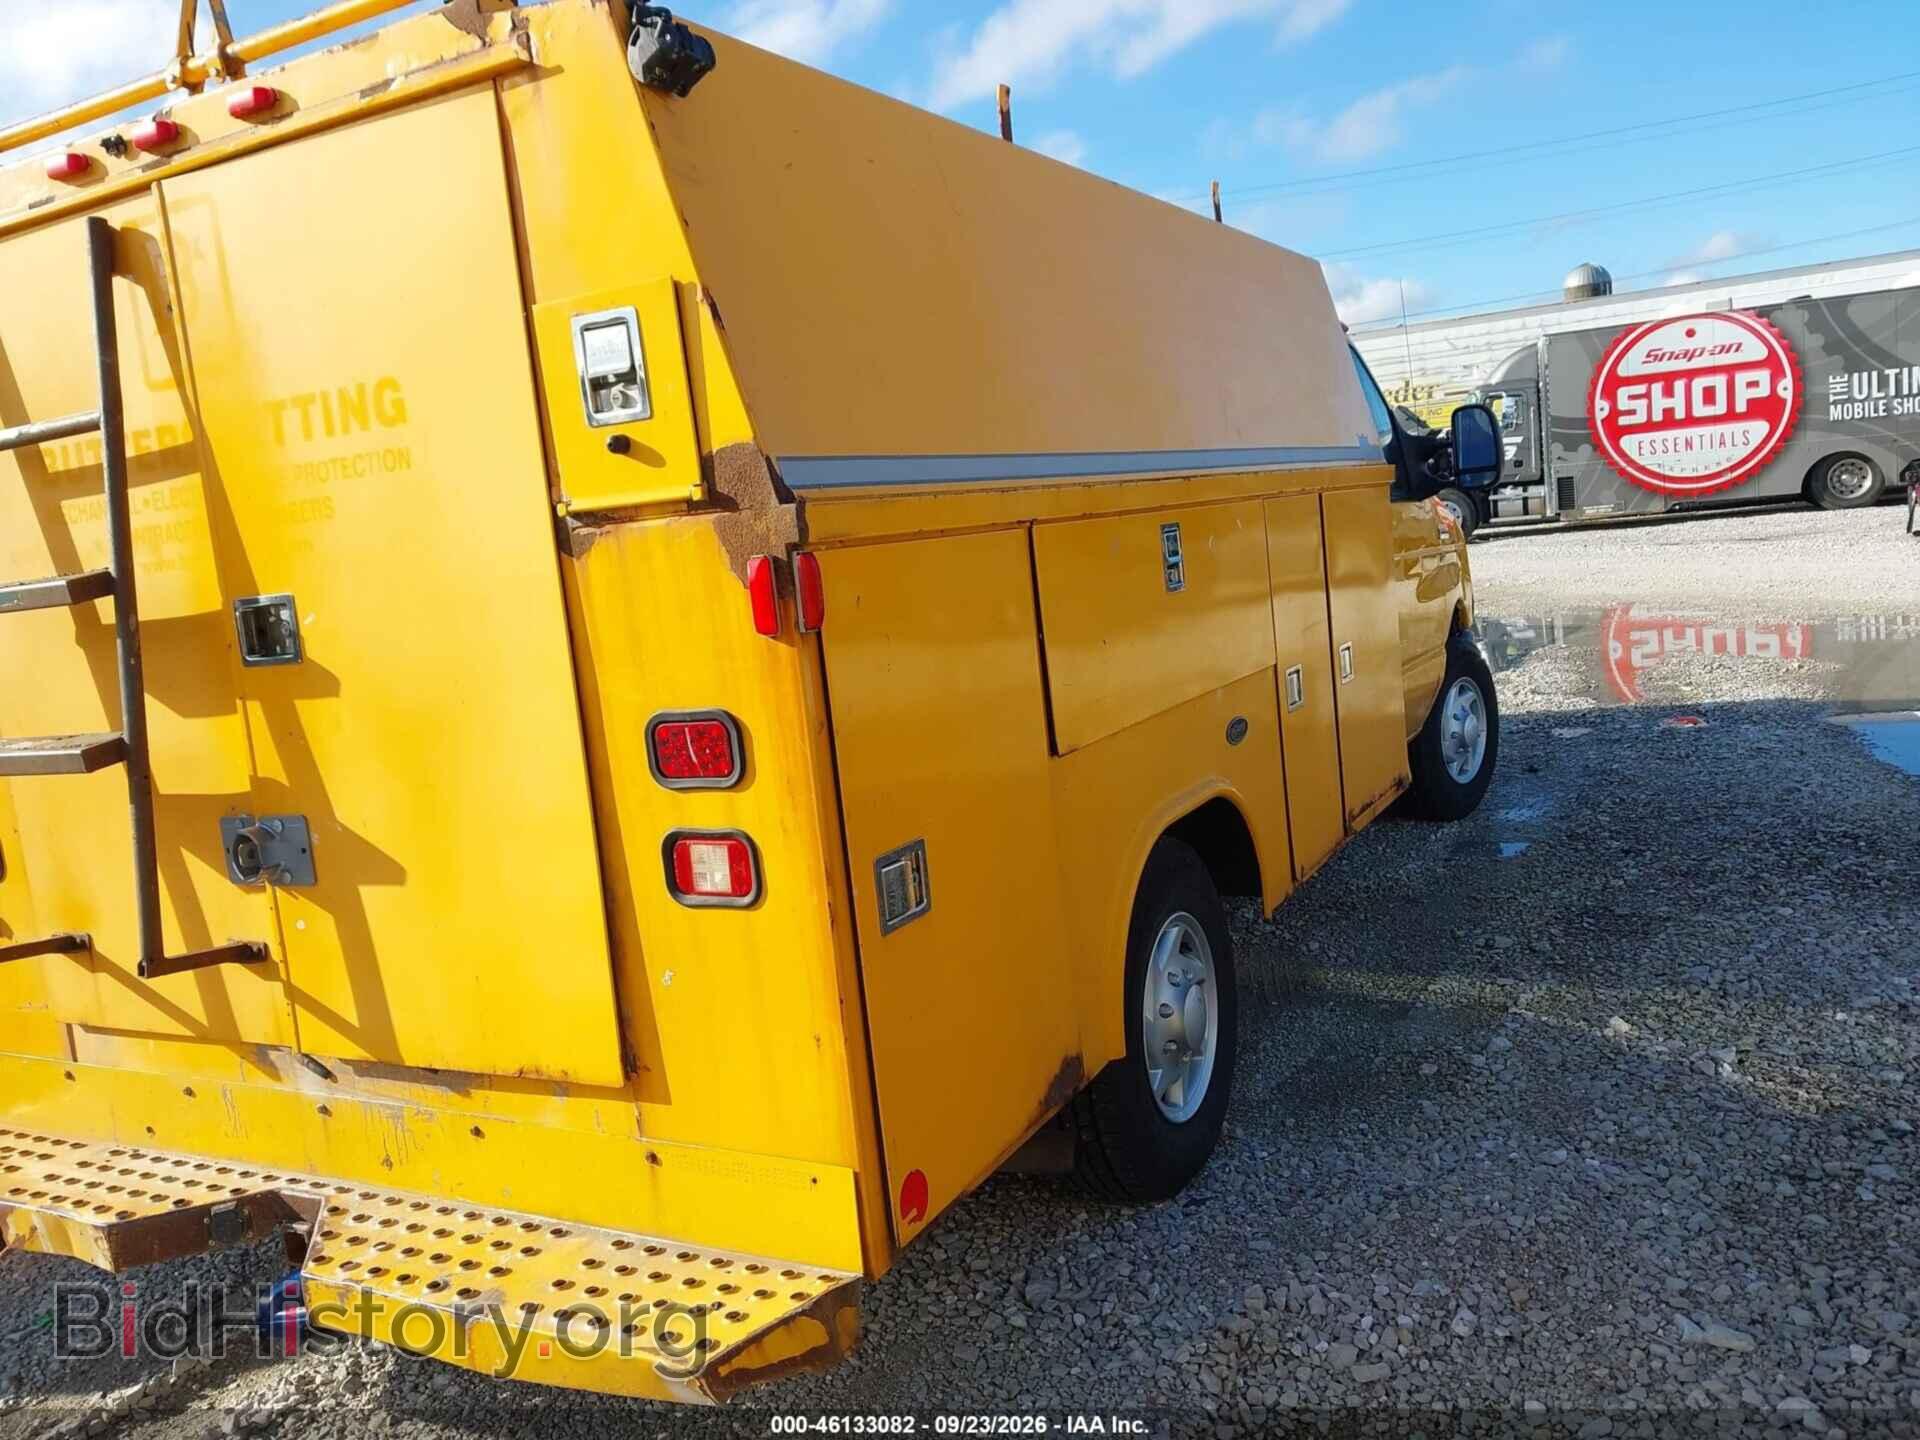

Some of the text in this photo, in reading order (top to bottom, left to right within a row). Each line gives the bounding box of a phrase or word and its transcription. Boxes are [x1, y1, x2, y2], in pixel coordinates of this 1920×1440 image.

[1642, 341, 1744, 364] Snap-on
[1616, 369, 1772, 426] SHOP
[1829, 373, 1849, 403] THE
[1829, 399, 1888, 421] MOBILE
[1638, 430, 1751, 457] ESSENTIALS
